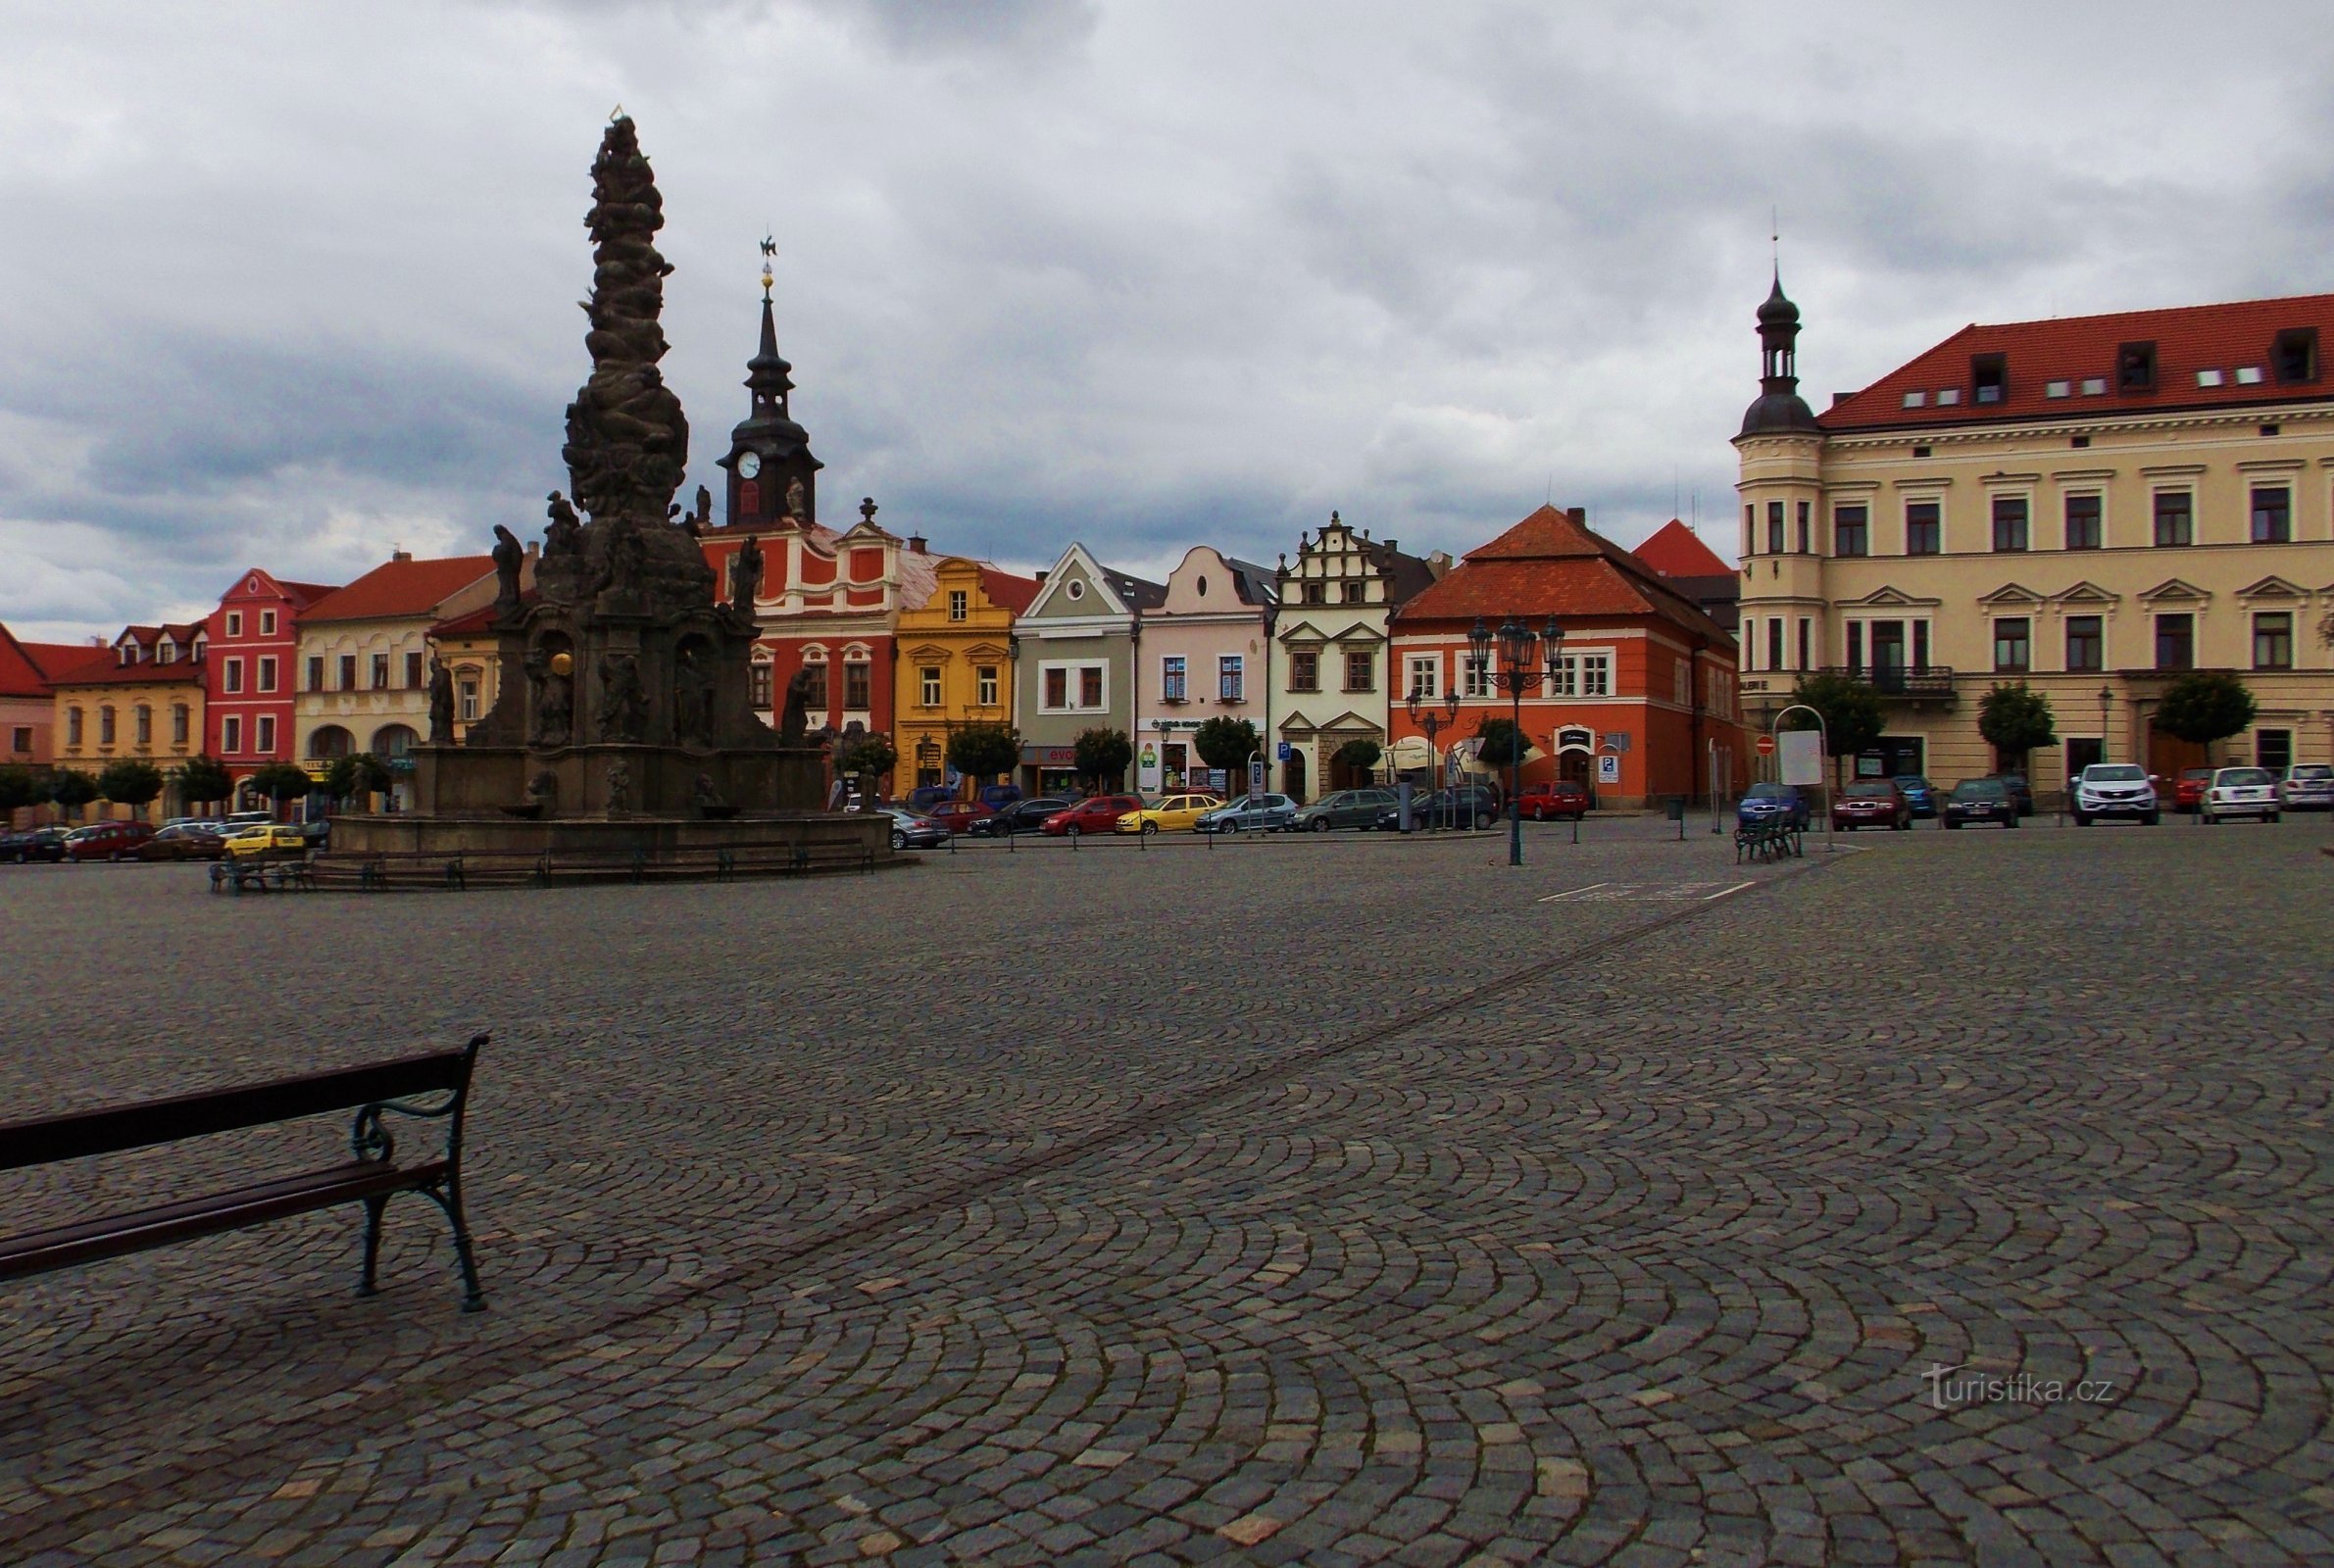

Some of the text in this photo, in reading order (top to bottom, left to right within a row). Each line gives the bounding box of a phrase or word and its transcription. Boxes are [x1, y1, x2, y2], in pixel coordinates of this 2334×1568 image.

[1280, 744, 1288, 754] P
[1050, 749, 1076, 760] evo
[1604, 758, 1612, 767] P
